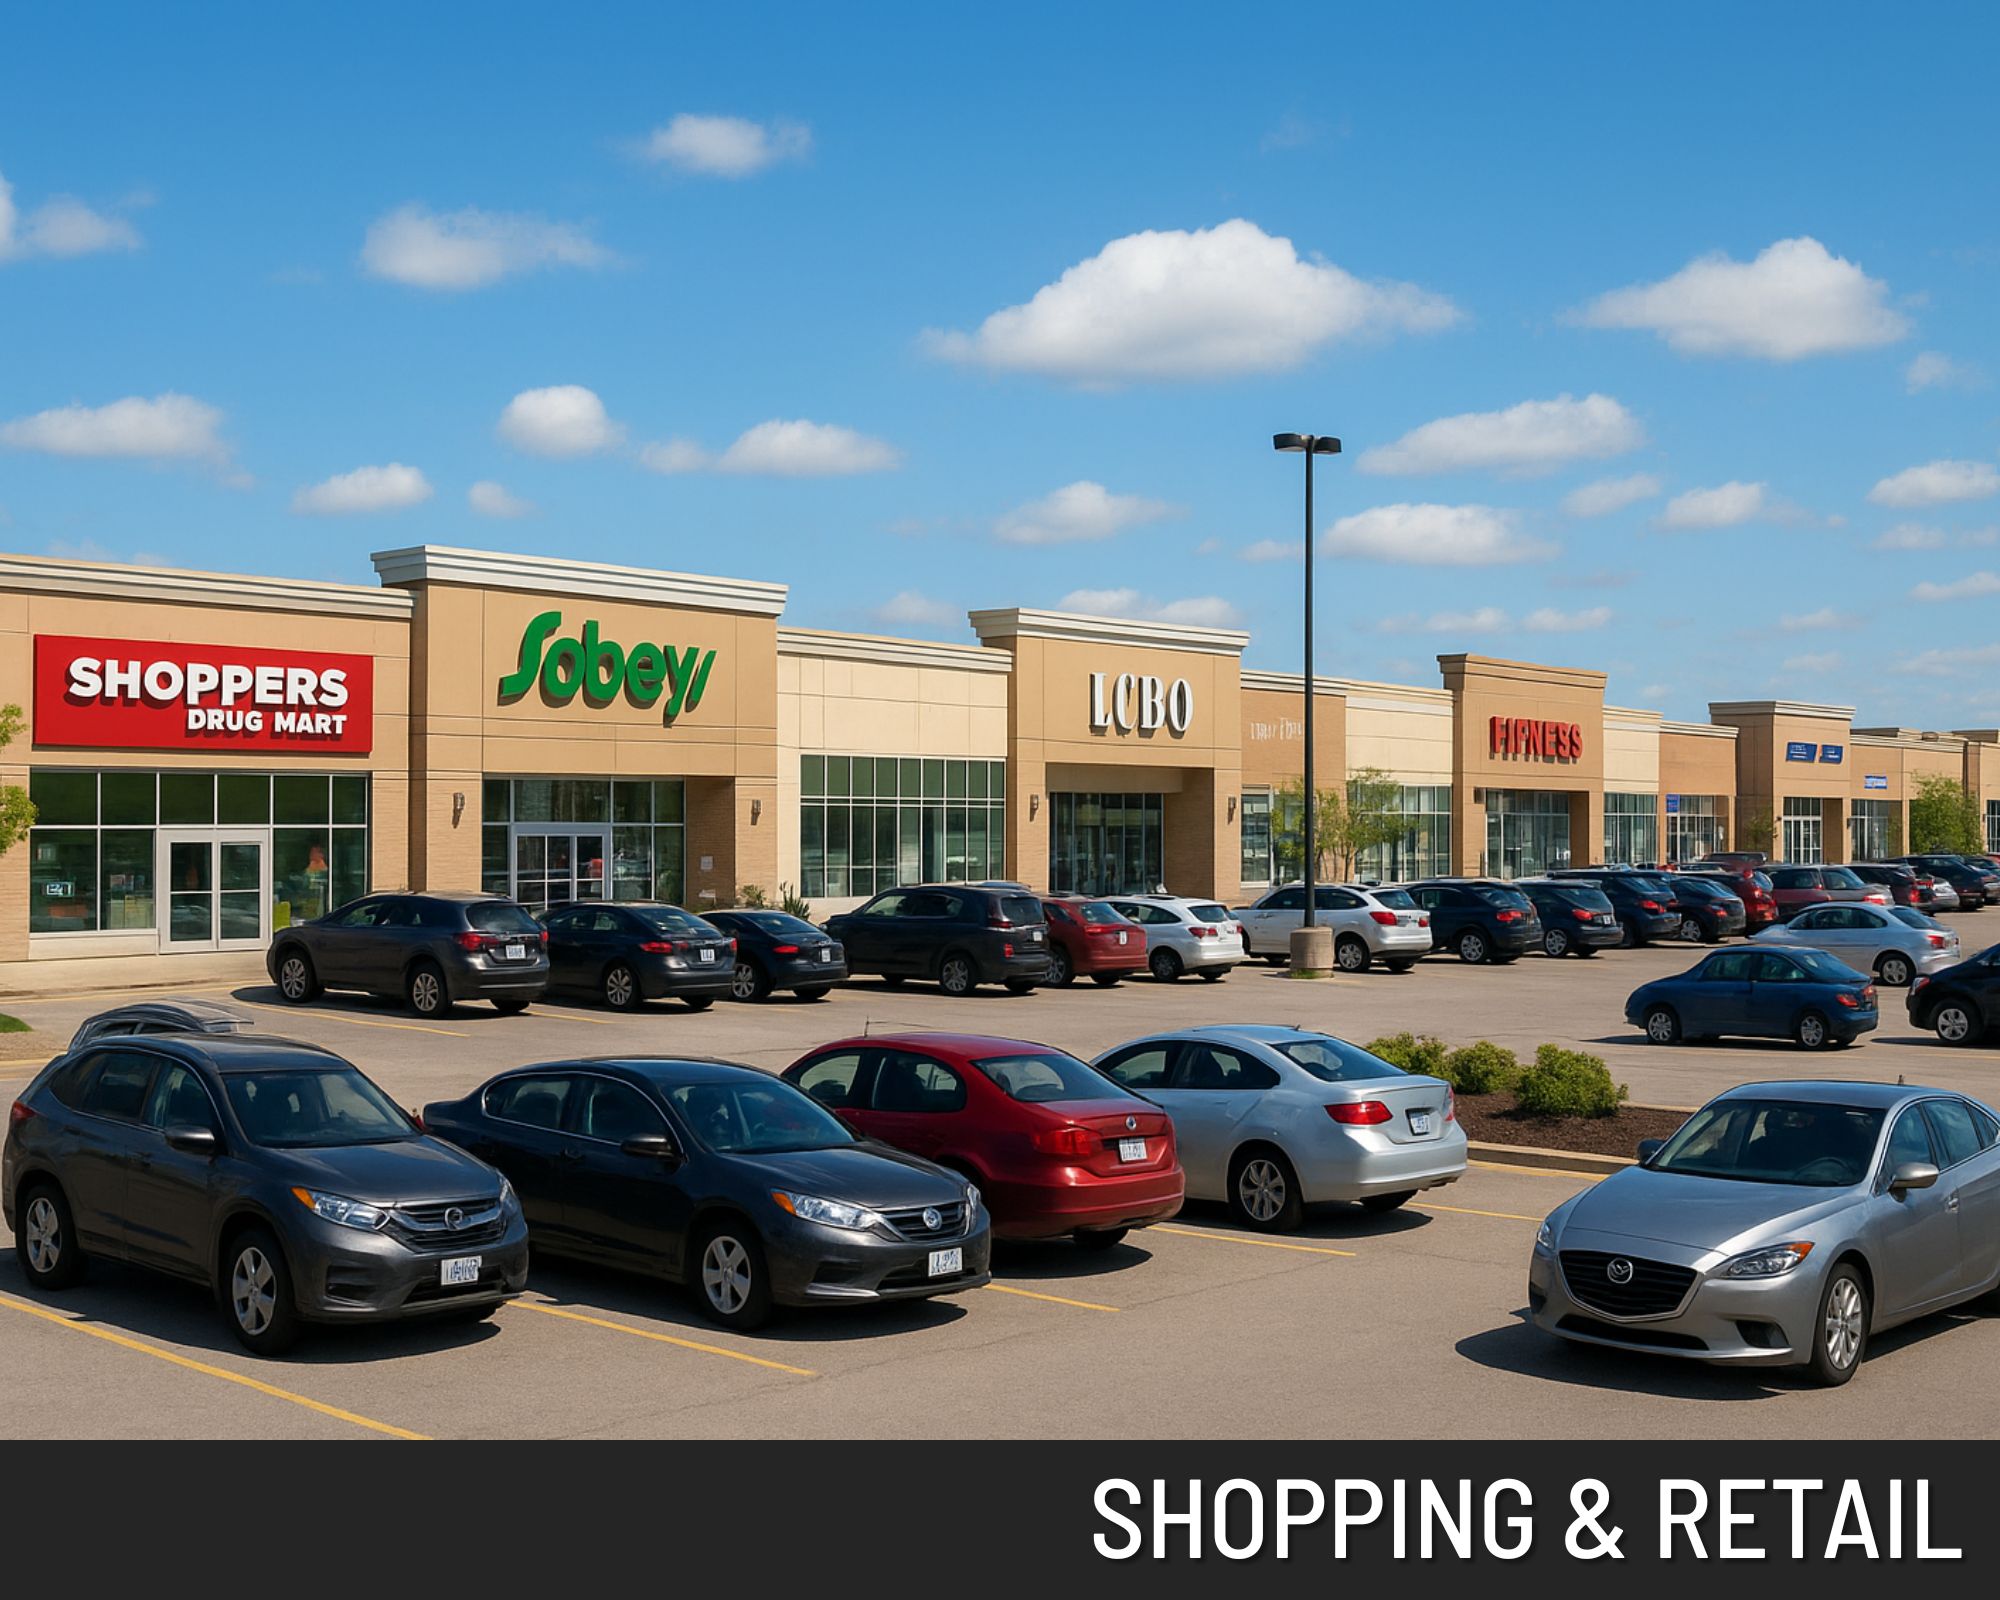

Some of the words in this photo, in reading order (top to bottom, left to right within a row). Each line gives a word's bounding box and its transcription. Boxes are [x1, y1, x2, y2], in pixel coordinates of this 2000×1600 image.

[69, 656, 348, 707] SHOPPERS
[1091, 672, 1194, 732] LCBO
[188, 709, 263, 732] DRUG
[274, 711, 347, 735] MART
